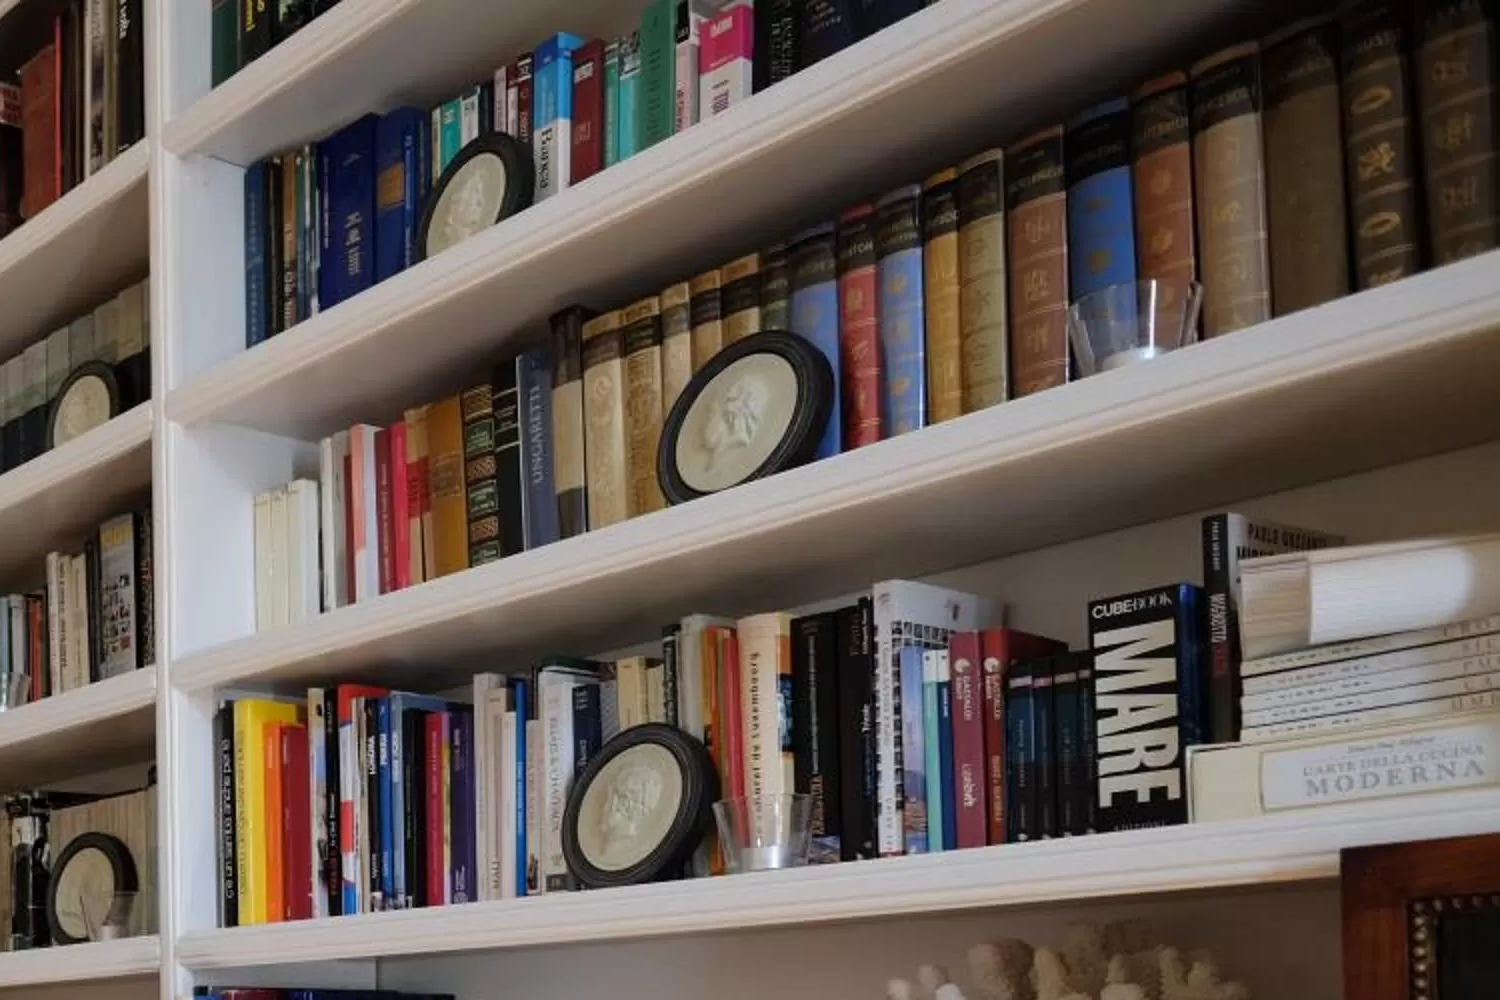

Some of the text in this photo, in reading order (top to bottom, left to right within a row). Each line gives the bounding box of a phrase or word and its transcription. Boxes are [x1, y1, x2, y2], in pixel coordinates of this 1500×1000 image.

[529, 385, 544, 485] UNGARETTI
[1093, 619, 1181, 809] MARE
[1306, 759, 1485, 798] MODERNA
[1360, 753, 1414, 772] DELLA
[1417, 744, 1484, 766] CUCINA
